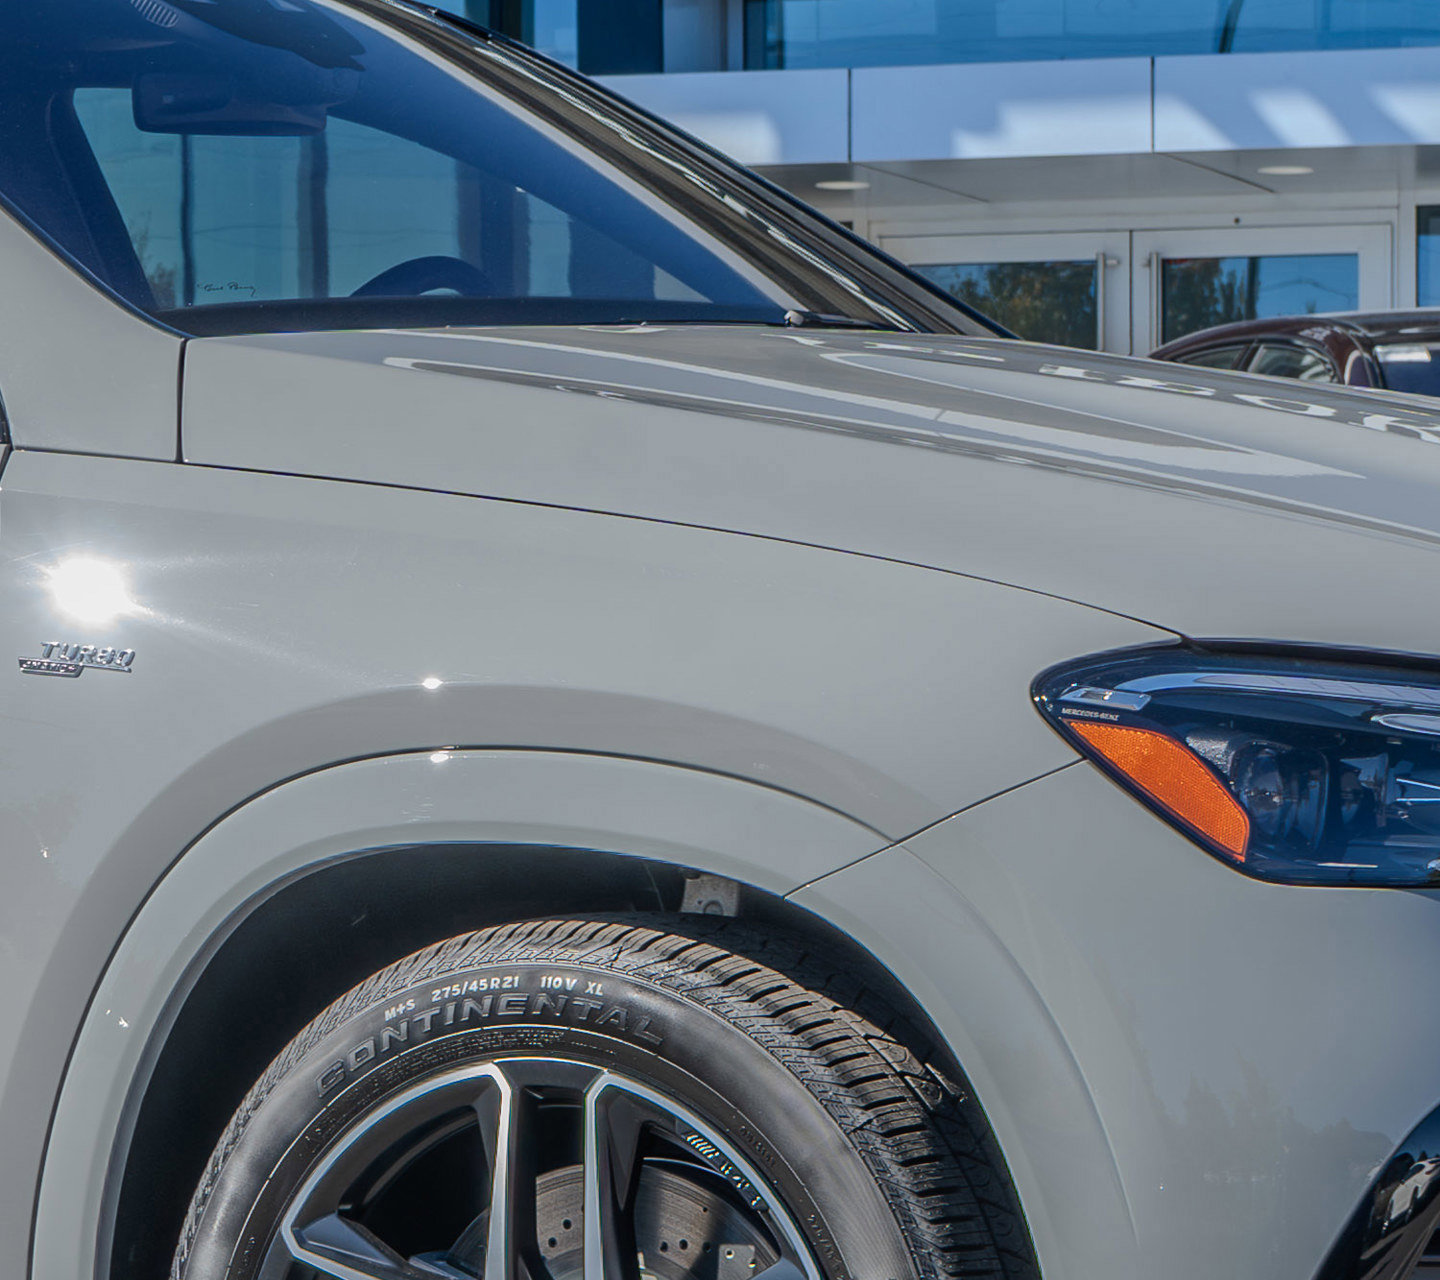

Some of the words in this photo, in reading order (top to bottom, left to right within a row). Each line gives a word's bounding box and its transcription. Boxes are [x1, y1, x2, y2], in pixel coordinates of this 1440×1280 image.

[40, 641, 136, 667] TURBO
[585, 981, 604, 996] XL
[384, 999, 416, 1021] M+S
[315, 991, 664, 1099] CONTINENTAL
